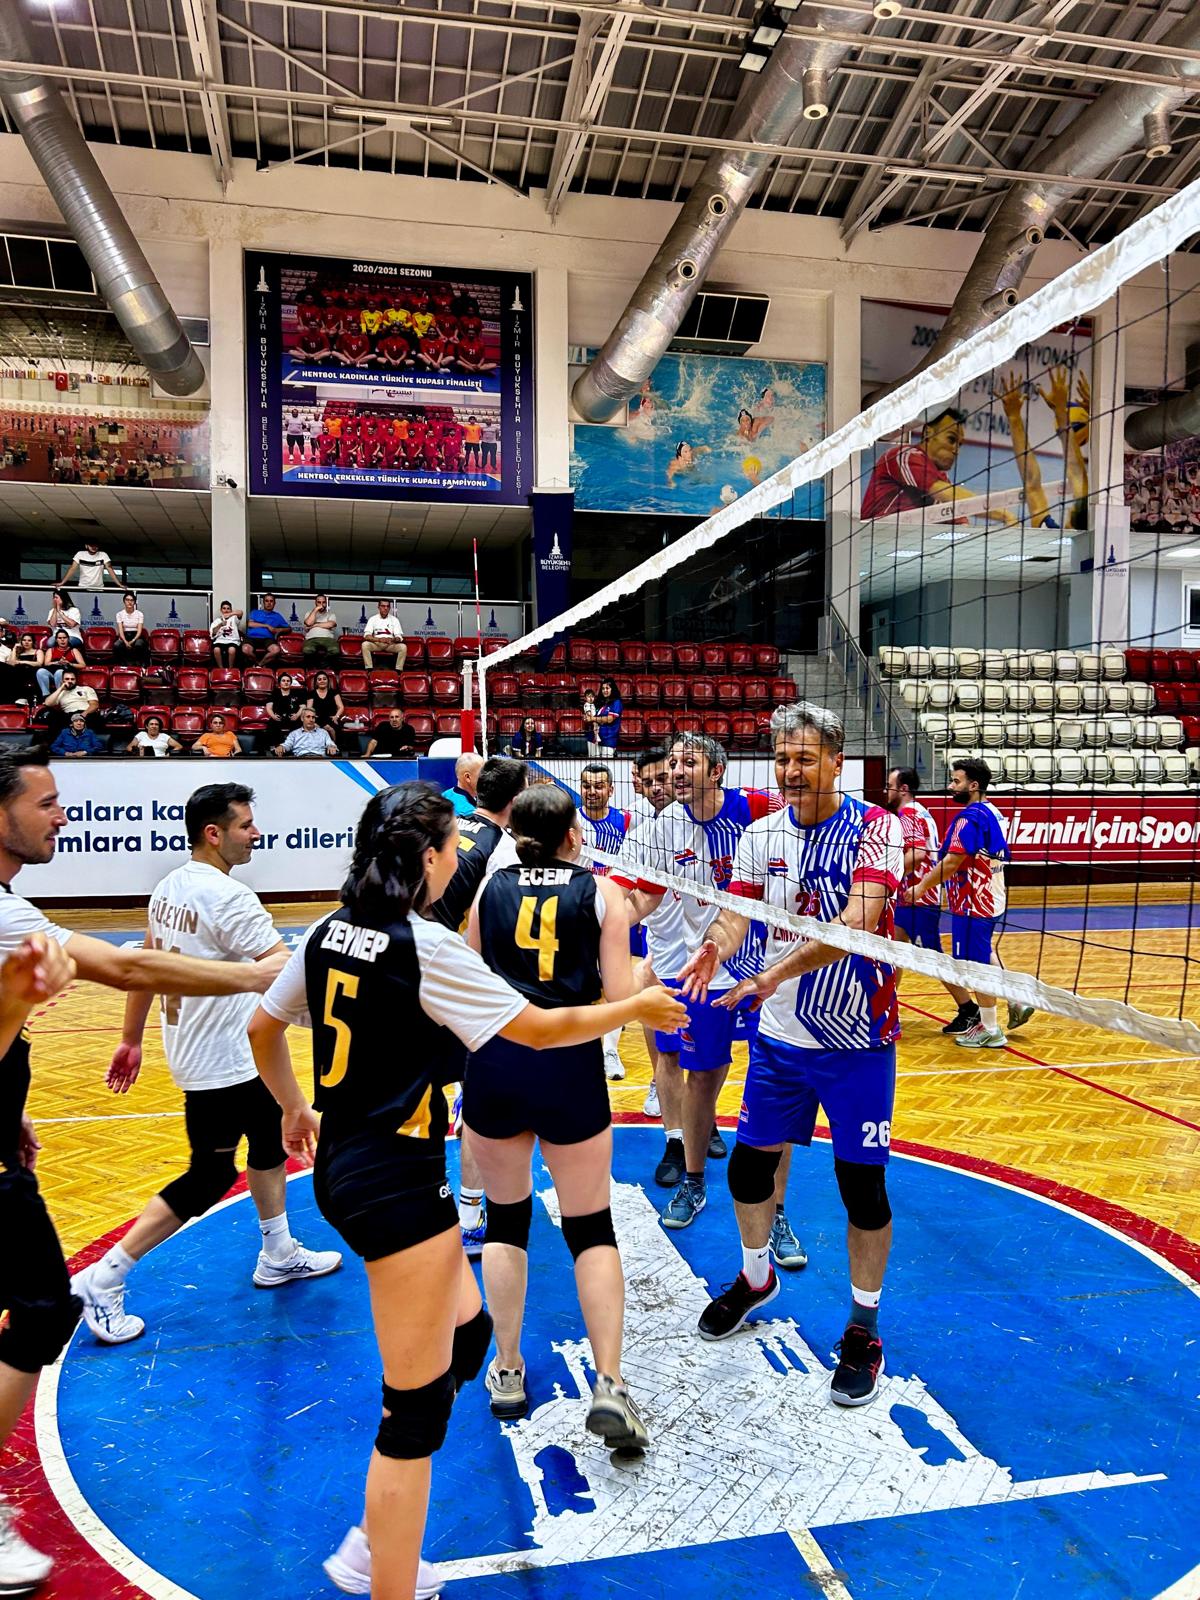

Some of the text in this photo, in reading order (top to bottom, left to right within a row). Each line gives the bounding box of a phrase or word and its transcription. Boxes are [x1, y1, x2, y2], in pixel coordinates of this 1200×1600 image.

[352, 264, 432, 278] 2020/2021 SEZONU
[302, 370, 337, 379] HENTBOL
[339, 373, 379, 382] KADINLAR
[381, 373, 414, 384] TÜRKİYE
[416, 377, 444, 386] KUPASI
[297, 472, 334, 480] HENTBOL
[335, 474, 375, 482] ERKEKLER
[377, 474, 410, 484] TÜRKİYE
[61, 800, 188, 821] alara ka
[58, 831, 141, 852] mlara
[286, 826, 356, 849] dileri
[518, 868, 574, 886] ECEM
[710, 855, 733, 883] 35
[795, 890, 821, 916] 26
[320, 919, 391, 963] ZEYNEP
[515, 896, 559, 981] 4
[319, 968, 360, 1088] 5
[862, 1120, 890, 1147] 26
